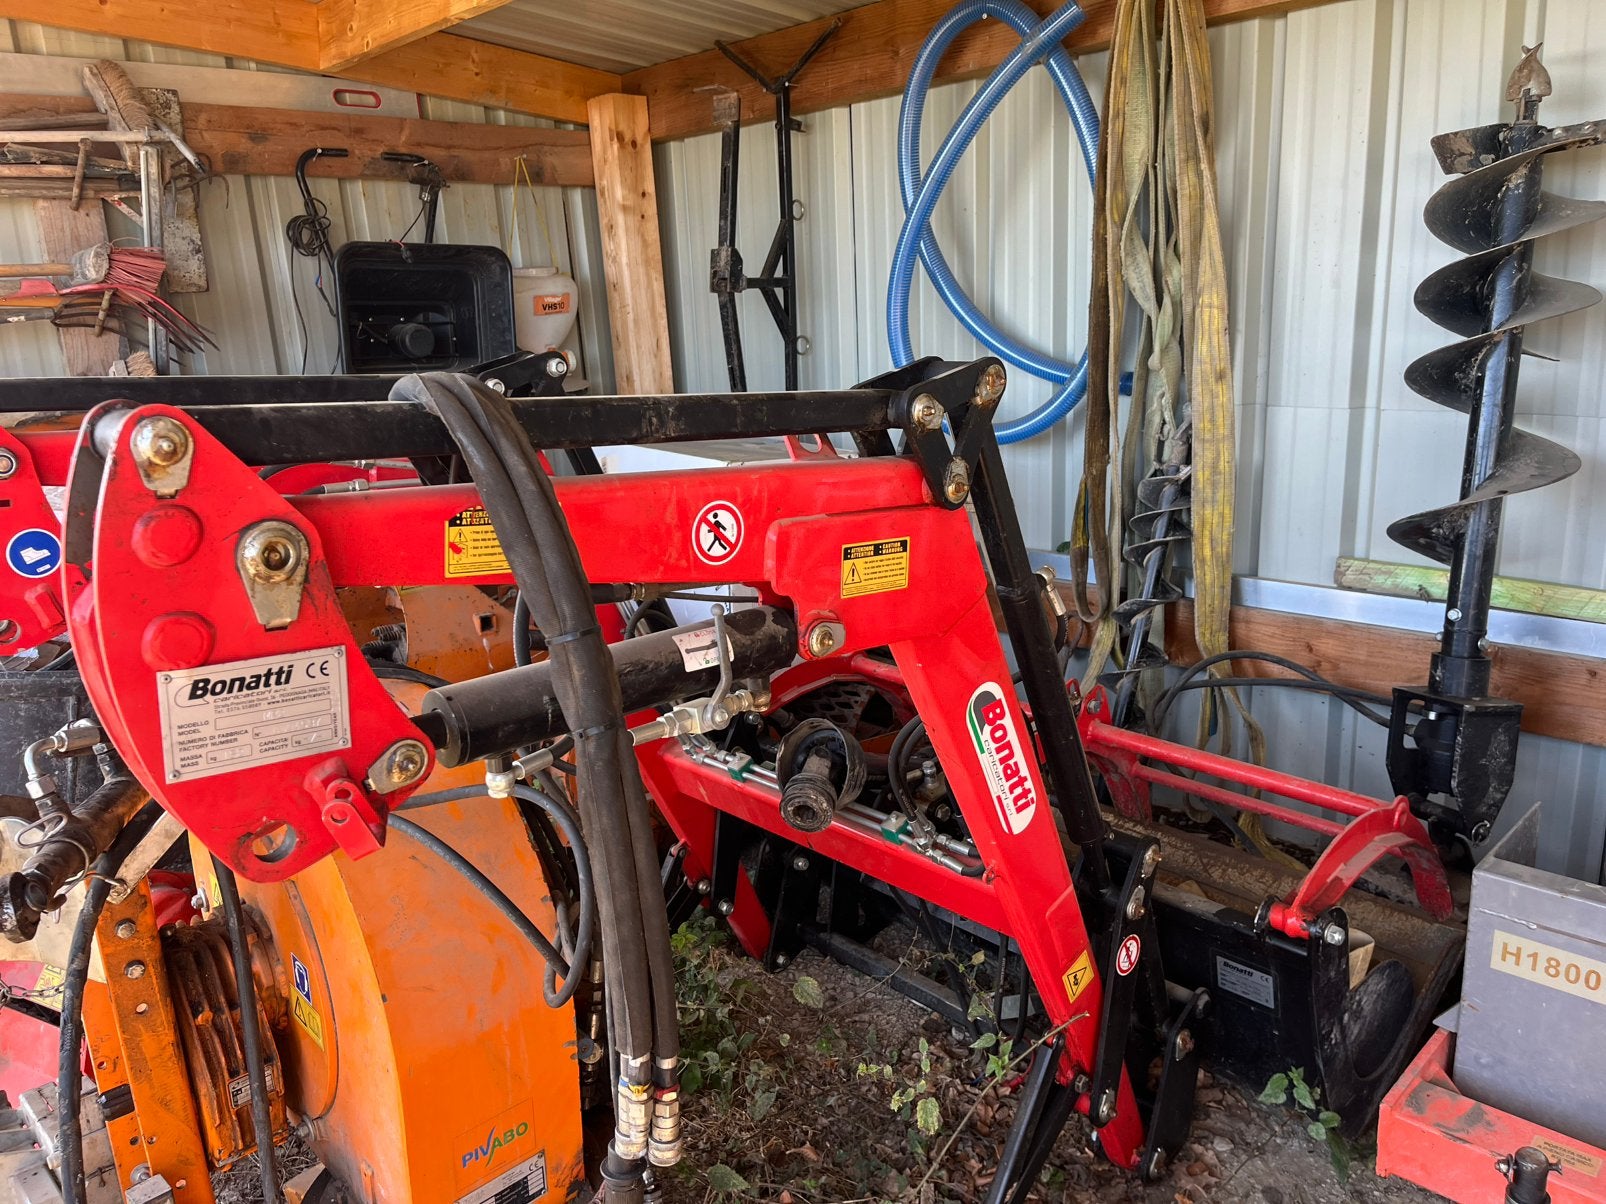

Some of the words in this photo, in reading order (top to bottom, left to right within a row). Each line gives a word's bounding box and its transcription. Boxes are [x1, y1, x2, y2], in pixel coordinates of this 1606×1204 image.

[542, 302, 565, 311] VHS10
[188, 664, 294, 701] Bonatti
[177, 720, 209, 730] MODELLO
[177, 728, 201, 737] MODEL
[178, 736, 208, 746] NUMERO
[217, 729, 249, 739] FABBRICA
[178, 743, 209, 752] FACTORY
[211, 737, 239, 747] NUMBER
[259, 744, 289, 753] CAPACITY
[980, 698, 1035, 815] Bonatti
[180, 754, 203, 762] MASSA
[984, 739, 1009, 801] caricatori
[1223, 961, 1254, 977] Bonatti
[1501, 942, 1602, 991] H1800
[462, 1121, 529, 1168] PIVABO
